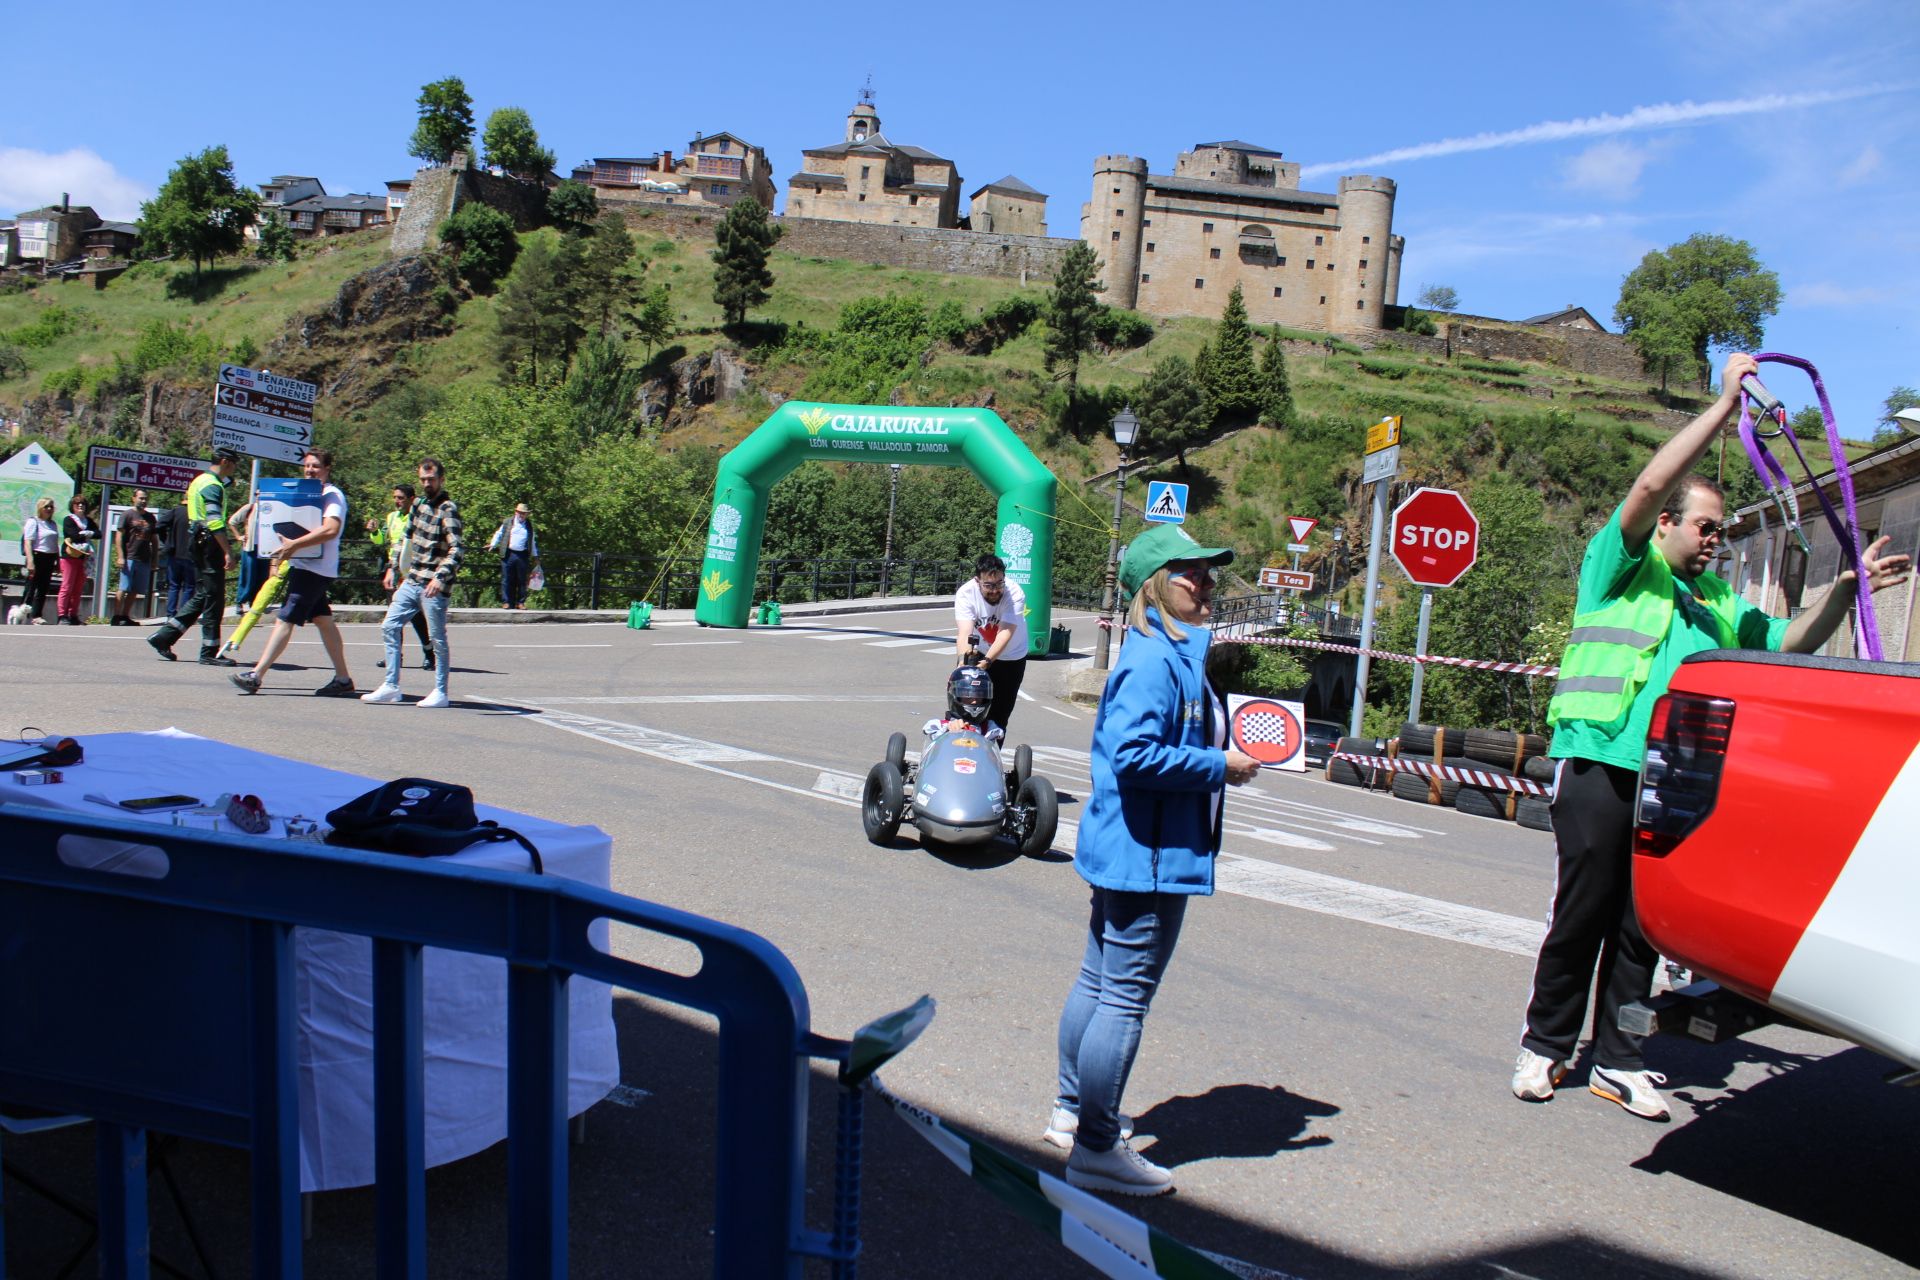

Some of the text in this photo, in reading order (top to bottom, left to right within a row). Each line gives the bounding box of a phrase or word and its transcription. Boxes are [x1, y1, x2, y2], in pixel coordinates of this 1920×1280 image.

[257, 373, 315, 394] BENAVENTE
[266, 384, 314, 402] OURENSE
[249, 401, 269, 413] Lago
[214, 430, 246, 442] centro
[214, 439, 247, 452] urbano
[809, 436, 949, 453] LEÓN OURENSE VALLADOLID ZAMORA
[147, 455, 197, 468] ZAMORANO
[140, 475, 191, 489] del Azog
[1401, 524, 1470, 551] STOP
[1283, 575, 1304, 586] Tera
